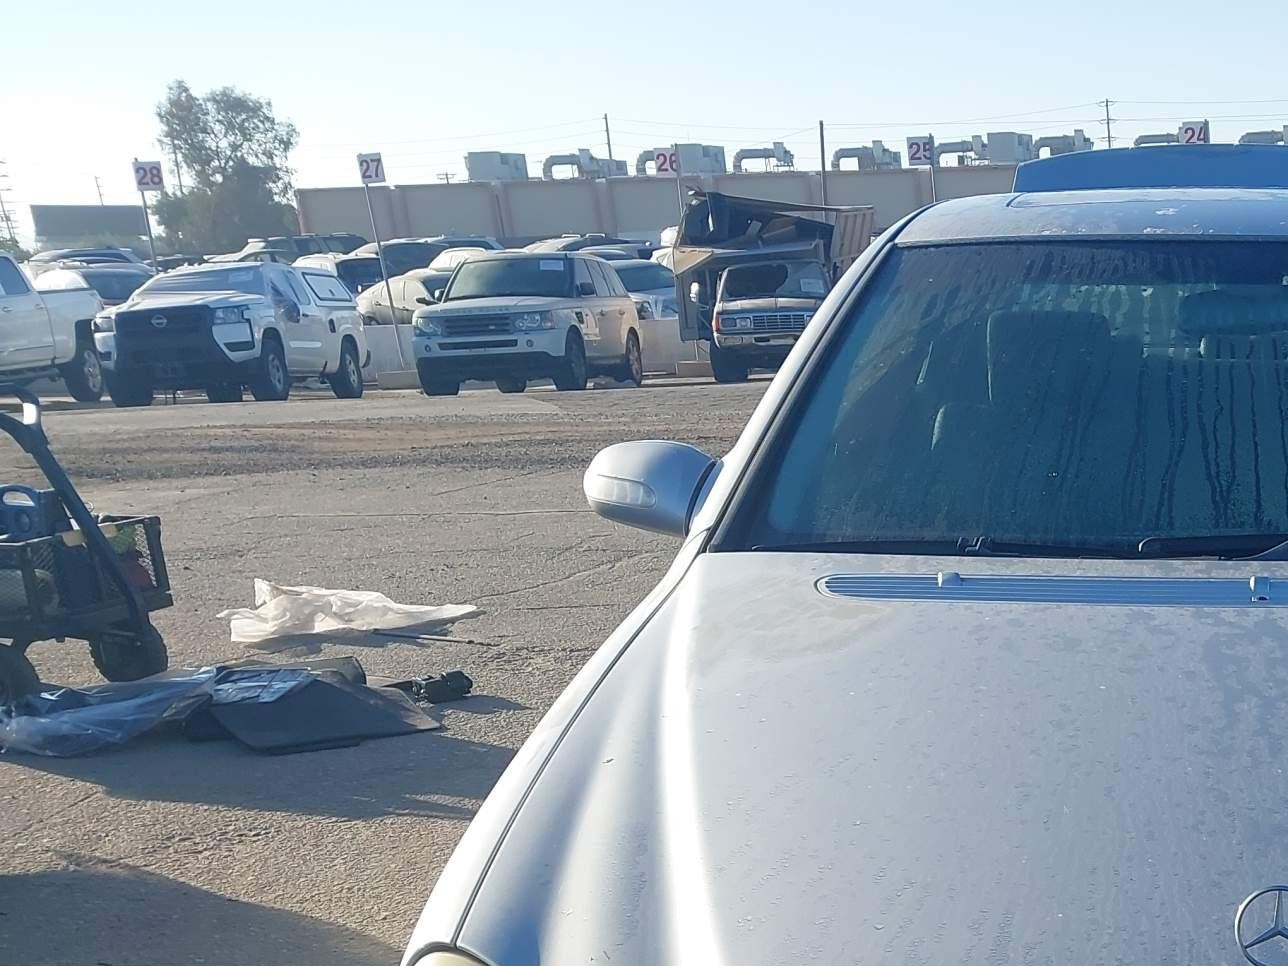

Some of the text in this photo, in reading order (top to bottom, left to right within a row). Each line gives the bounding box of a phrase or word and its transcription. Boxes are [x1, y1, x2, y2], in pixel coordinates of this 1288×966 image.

[1184, 126, 1208, 143] 24
[909, 142, 932, 160] 25
[360, 159, 381, 178] 27
[656, 153, 678, 171] 26
[136, 166, 161, 185] 28
